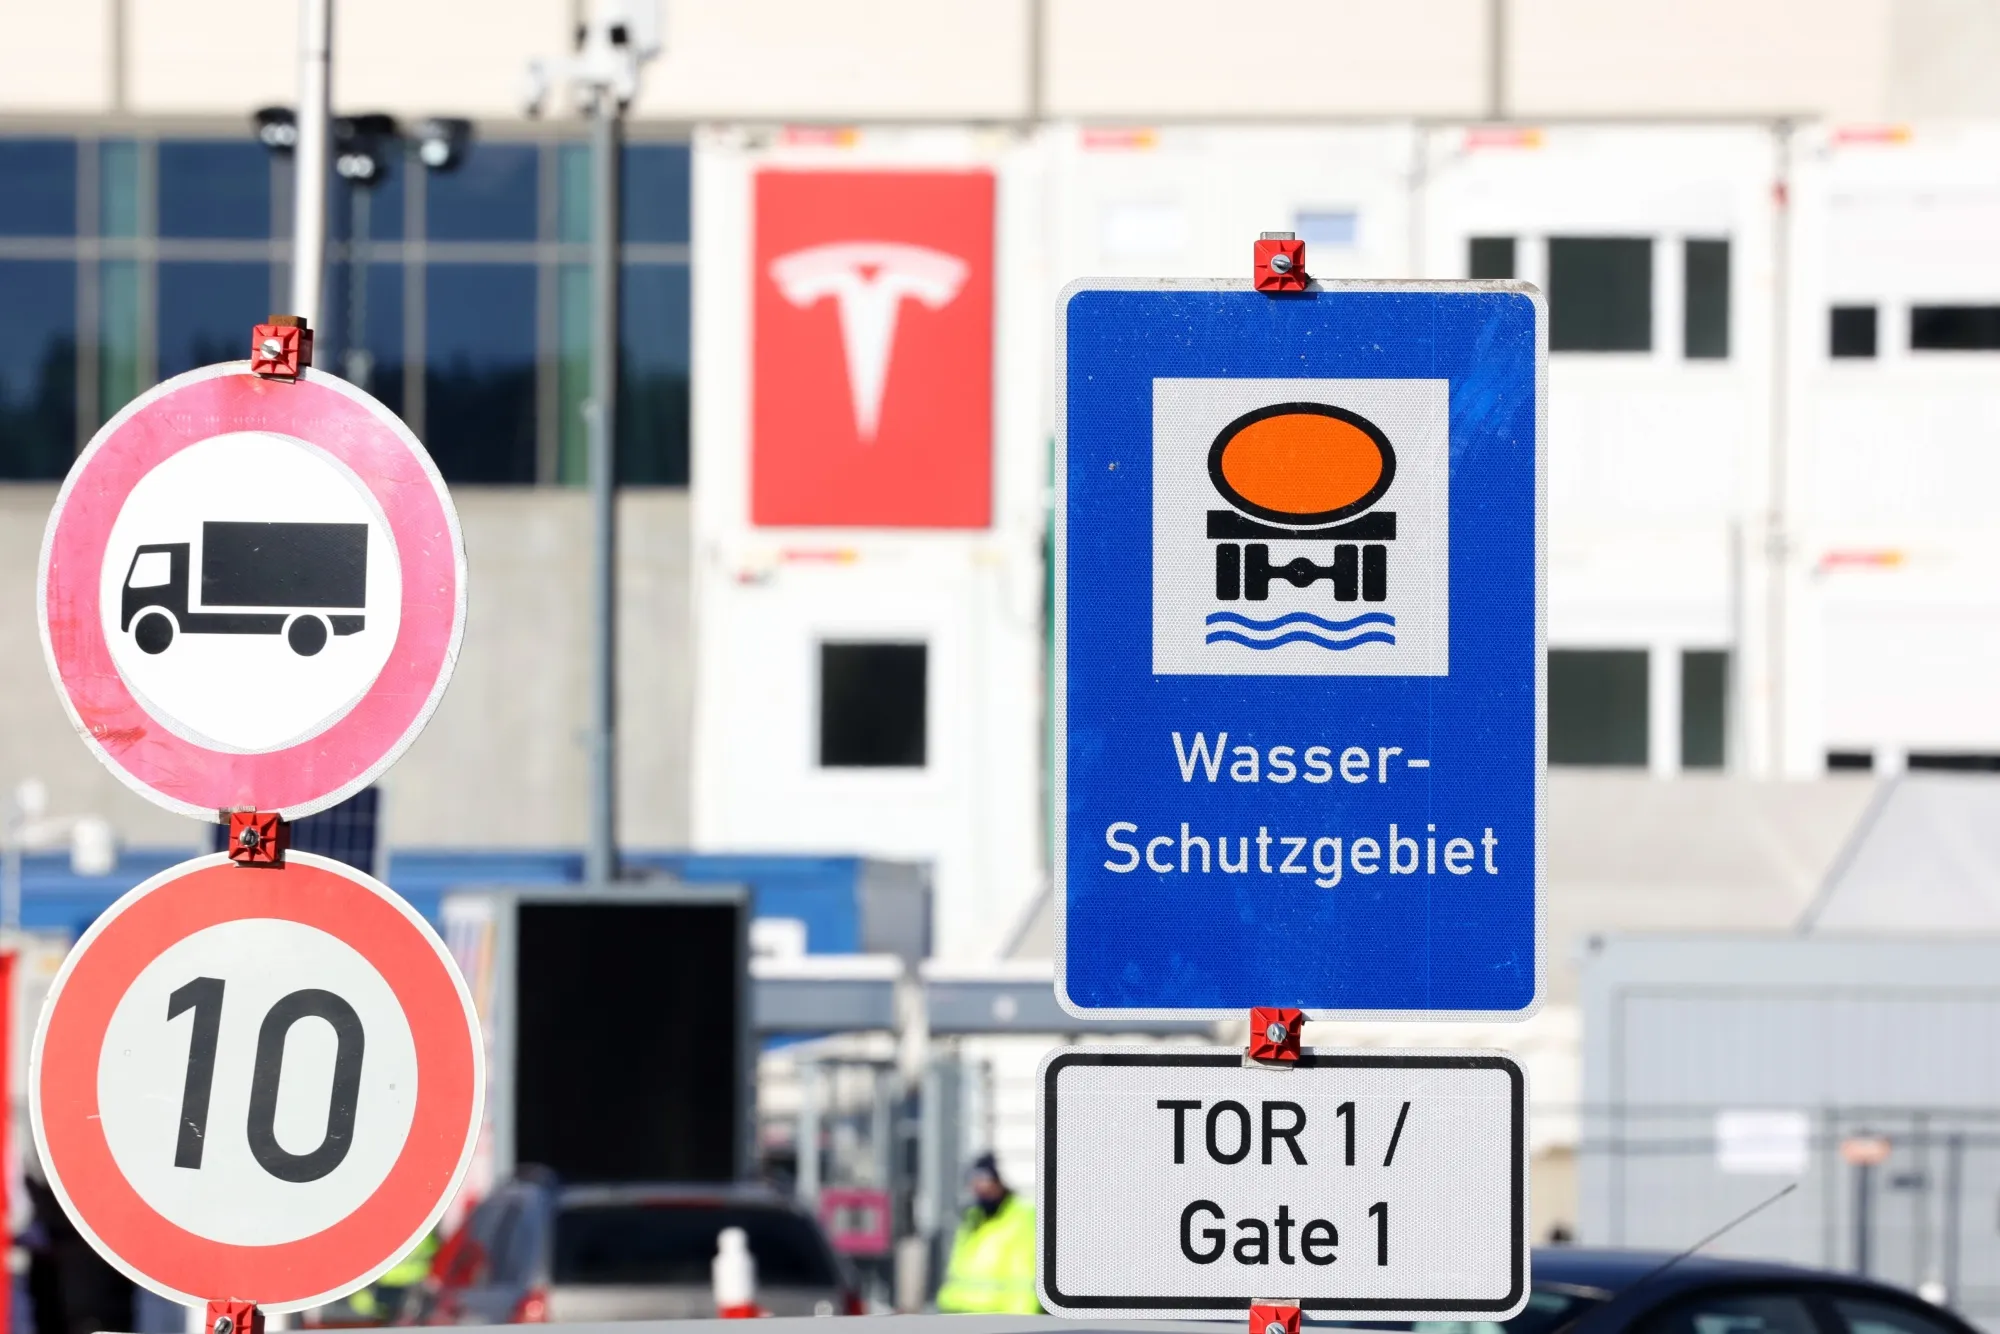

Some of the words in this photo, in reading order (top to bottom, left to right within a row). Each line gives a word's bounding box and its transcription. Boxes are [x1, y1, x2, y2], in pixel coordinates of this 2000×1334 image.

[1170, 730, 1431, 785] Wasser-
[1103, 821, 1499, 890] Schutzgebiet
[167, 976, 365, 1183] 10
[1156, 1099, 1308, 1167] TOR
[1179, 1199, 1340, 1266] Gate
[1367, 1200, 1388, 1266] 1
